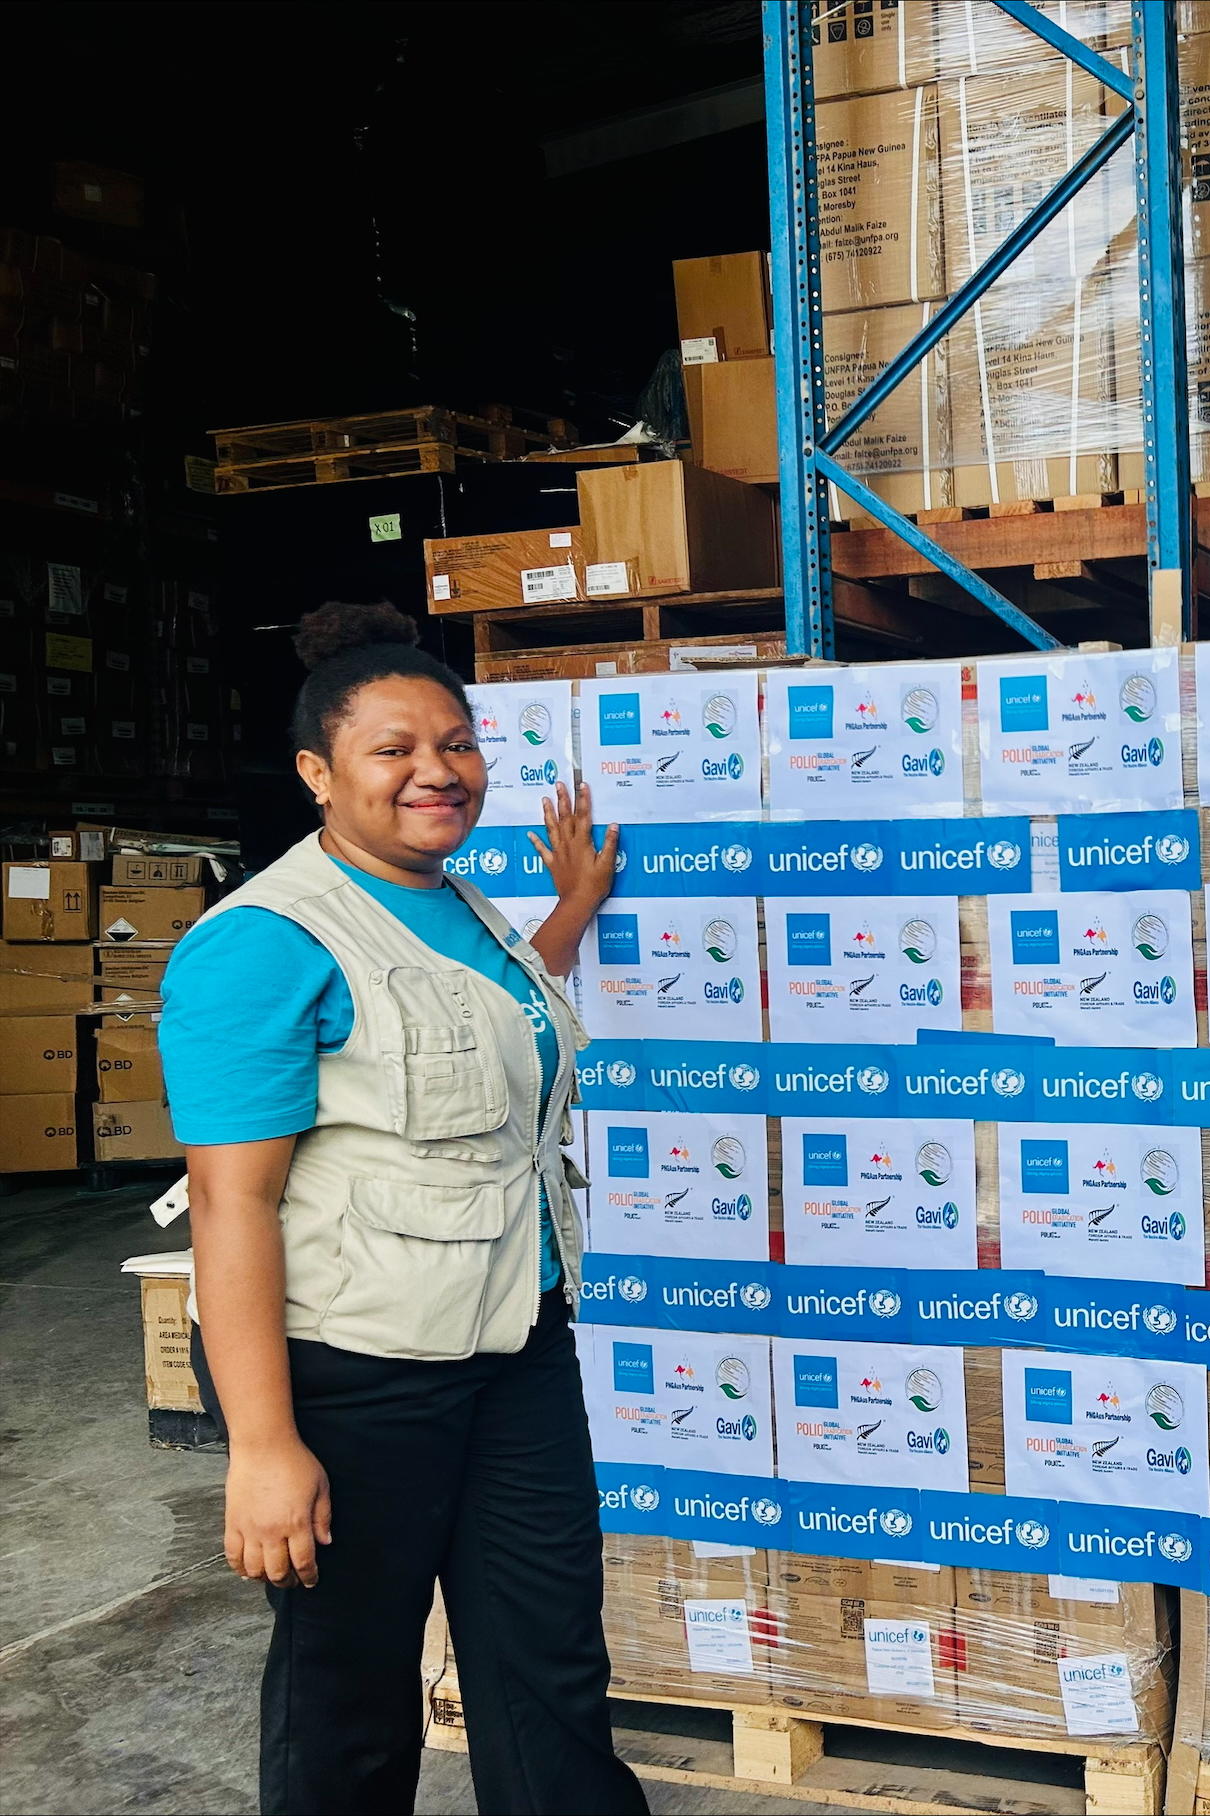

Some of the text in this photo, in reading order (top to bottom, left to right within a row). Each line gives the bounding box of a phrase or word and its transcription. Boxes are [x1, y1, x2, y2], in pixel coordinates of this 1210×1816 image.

[832, 143, 906, 161] Papua New Guinea
[828, 165, 836, 173] 14
[838, 164, 855, 172] Kina
[838, 174, 861, 184] Street
[822, 188, 856, 199] Box 1041
[824, 200, 856, 212] Moresby
[820, 221, 887, 236] Abdul Malik Faize
[824, 365, 850, 375] UNFPA
[1198, 368, 1208, 376] of
[825, 378, 846, 388] Level
[825, 390, 856, 400] Douglas
[864, 435, 906, 444] Malik Faize
[1121, 744, 1147, 763] Gavi
[702, 756, 726, 775] Gavi
[644, 846, 718, 873] unicef
[770, 845, 848, 871] unicef
[902, 842, 984, 869] unicef
[1069, 836, 1152, 866] unicef
[443, 850, 476, 874] cef
[704, 982, 728, 1001] Gavi
[57, 1050, 73, 1058] BD
[114, 1060, 132, 1070] BD
[575, 1062, 603, 1085] cef
[652, 1065, 725, 1087] unicef
[777, 1067, 853, 1091] unicef
[907, 1069, 988, 1094] unicef
[1044, 1072, 1128, 1097] unicef
[58, 1128, 74, 1136] BD
[114, 1126, 132, 1135] BD
[1142, 1216, 1167, 1235] Gavi
[581, 1276, 615, 1299] cef
[664, 1283, 737, 1306] unicef
[788, 1290, 866, 1315] unicef
[920, 1293, 1000, 1319] unicef
[1055, 1303, 1139, 1329] unicef
[1147, 1448, 1174, 1469] Gavi
[599, 1485, 627, 1508] cef
[676, 1495, 748, 1520] unicef
[800, 1507, 876, 1533] unicef
[931, 1517, 1012, 1544] unicef
[1069, 1530, 1154, 1556] unicef
[689, 1608, 727, 1622] unicef
[868, 1628, 909, 1644] unicef
[1063, 1664, 1107, 1682] unicef
